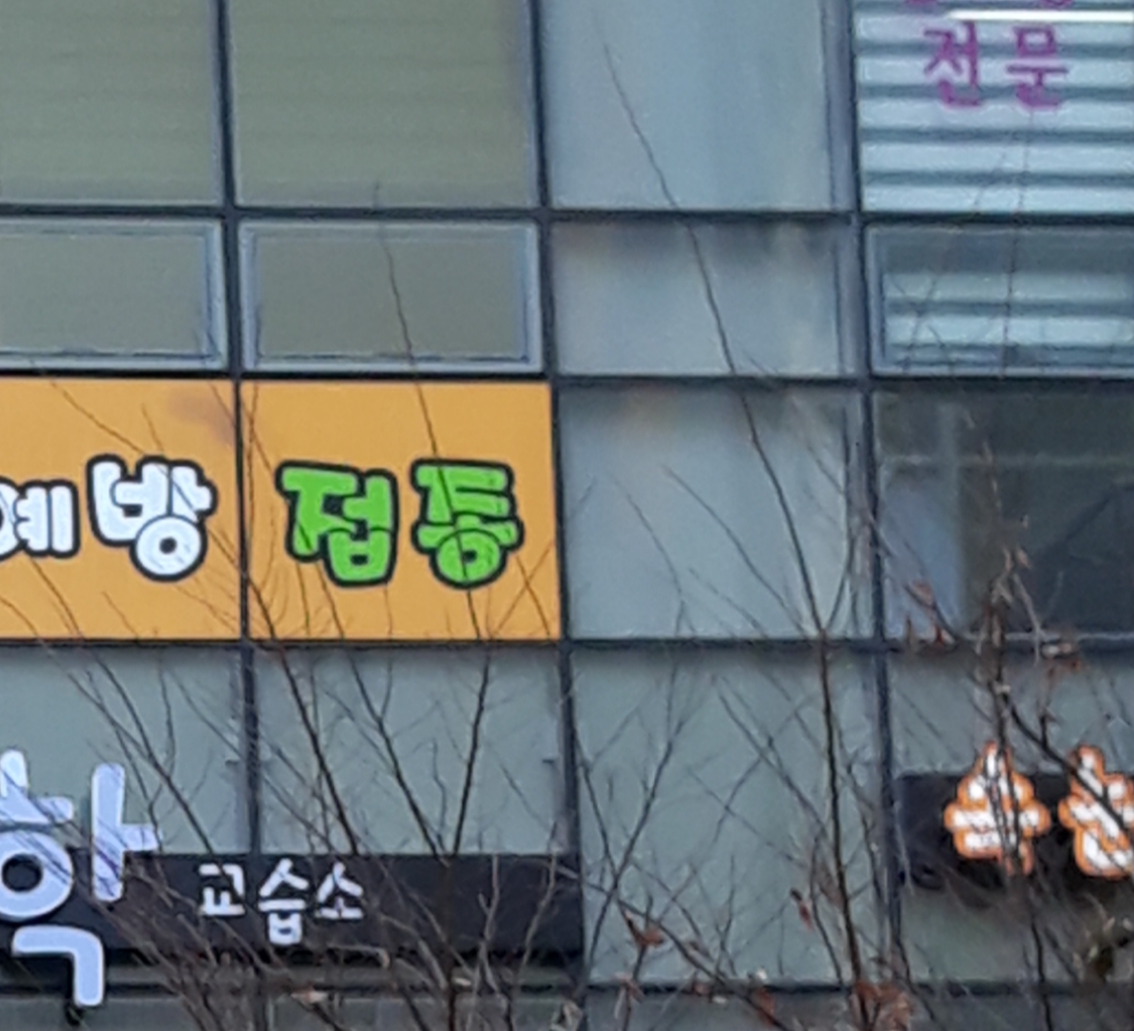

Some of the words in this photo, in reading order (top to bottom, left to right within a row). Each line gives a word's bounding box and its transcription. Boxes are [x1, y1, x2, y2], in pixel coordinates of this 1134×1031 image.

[923, 20, 1070, 108] 전문
[275, 458, 524, 591] 접종
[198, 858, 364, 945] 교습소
